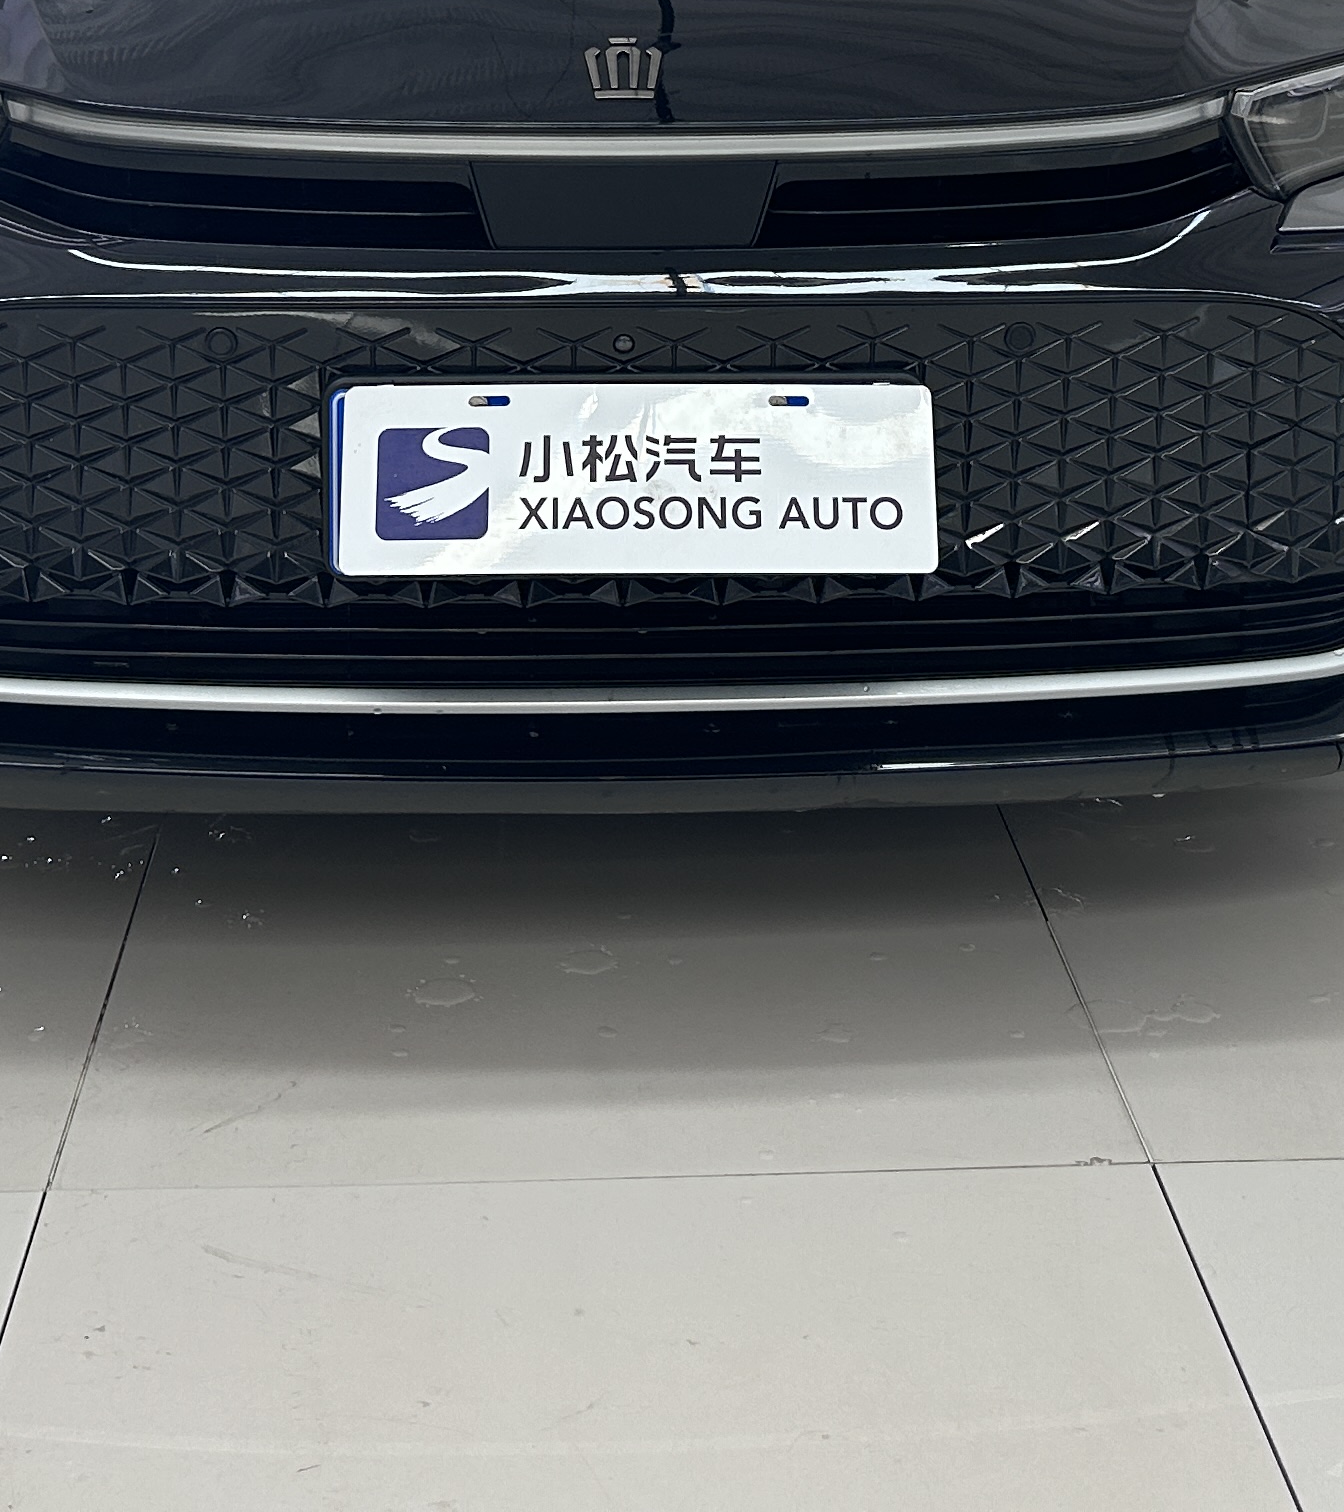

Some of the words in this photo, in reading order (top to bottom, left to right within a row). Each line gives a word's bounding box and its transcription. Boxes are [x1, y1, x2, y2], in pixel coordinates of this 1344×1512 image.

[519, 434, 762, 483] 小松汽车
[518, 495, 763, 531] XIAOSONG
[779, 495, 904, 531] AUTO
